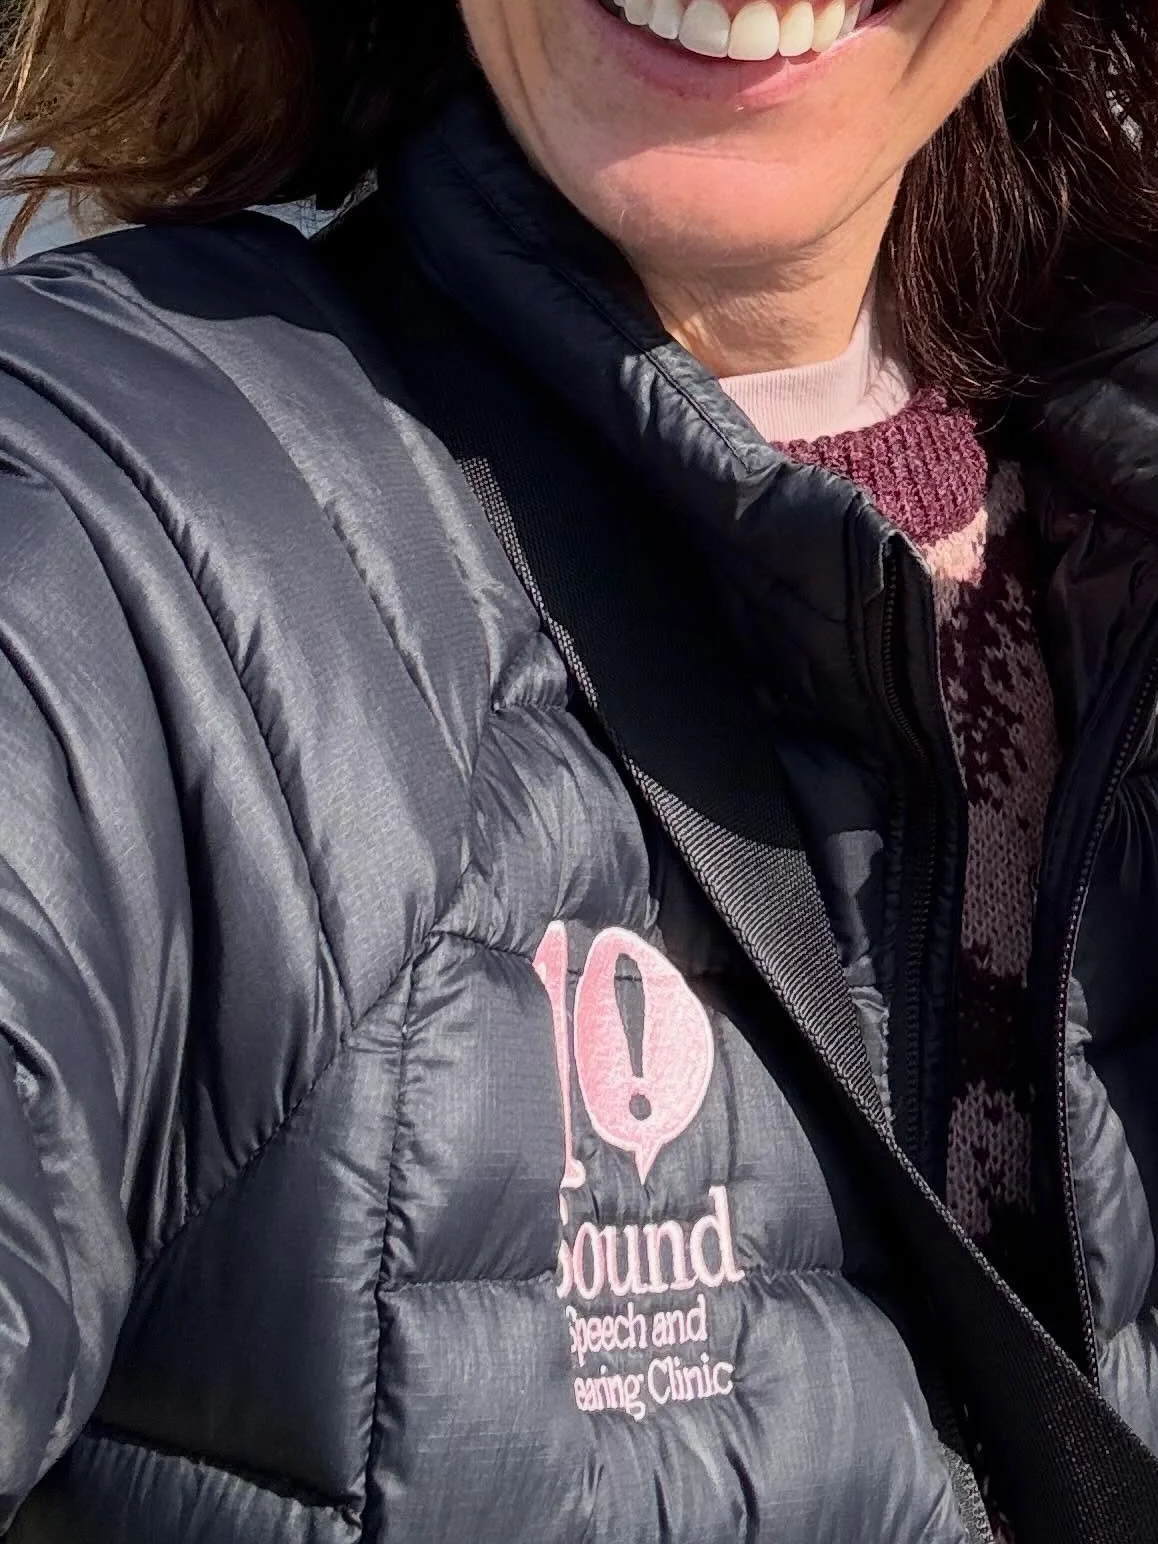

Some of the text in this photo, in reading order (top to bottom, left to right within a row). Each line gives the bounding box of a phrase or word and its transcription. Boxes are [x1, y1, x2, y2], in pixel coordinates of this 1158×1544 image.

[652, 1293, 708, 1348] and
[573, 1352, 734, 1420] earing Clinic
